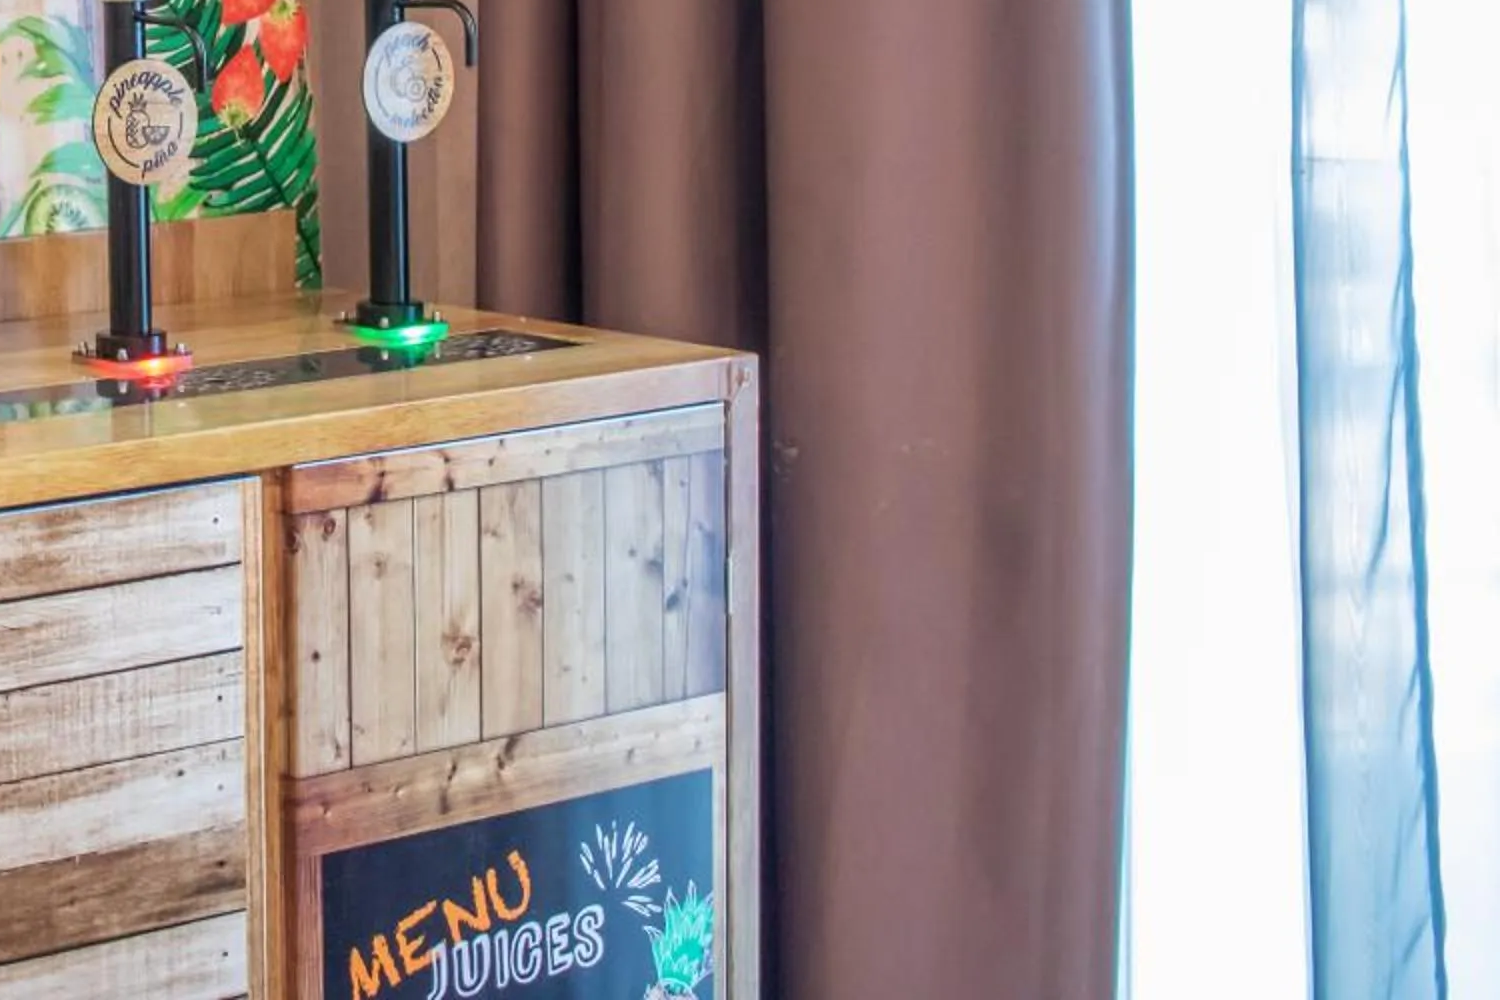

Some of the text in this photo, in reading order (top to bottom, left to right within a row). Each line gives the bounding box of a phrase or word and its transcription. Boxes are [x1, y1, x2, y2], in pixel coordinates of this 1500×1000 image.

[109, 71, 184, 119] pineapple
[347, 849, 532, 1000] MENU
[427, 904, 606, 1000] JUICES
